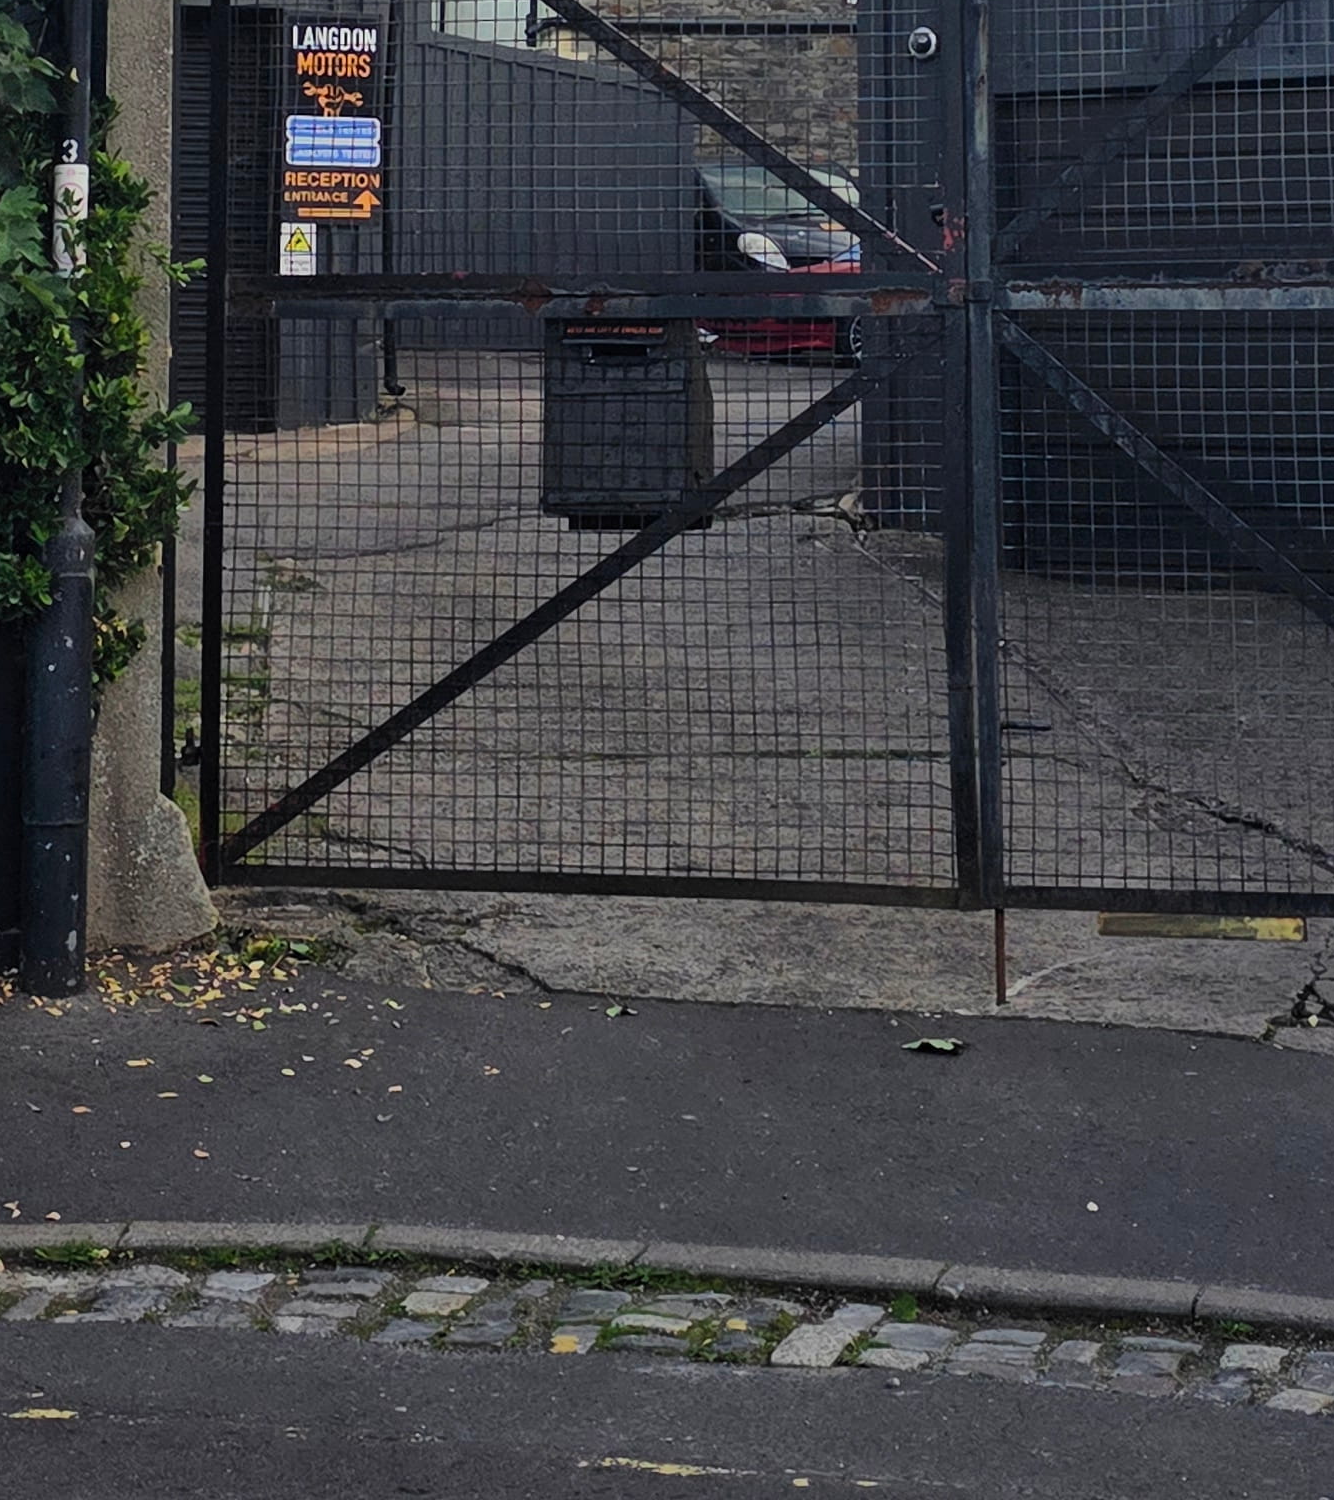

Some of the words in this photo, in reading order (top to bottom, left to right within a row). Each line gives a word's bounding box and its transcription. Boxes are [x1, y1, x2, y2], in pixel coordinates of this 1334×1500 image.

[292, 25, 377, 52] LANGDON
[297, 52, 372, 78] MOTORS
[61, 138, 79, 164] 3
[284, 171, 381, 188] RECEPTION
[284, 190, 349, 203] ENTRANCE
